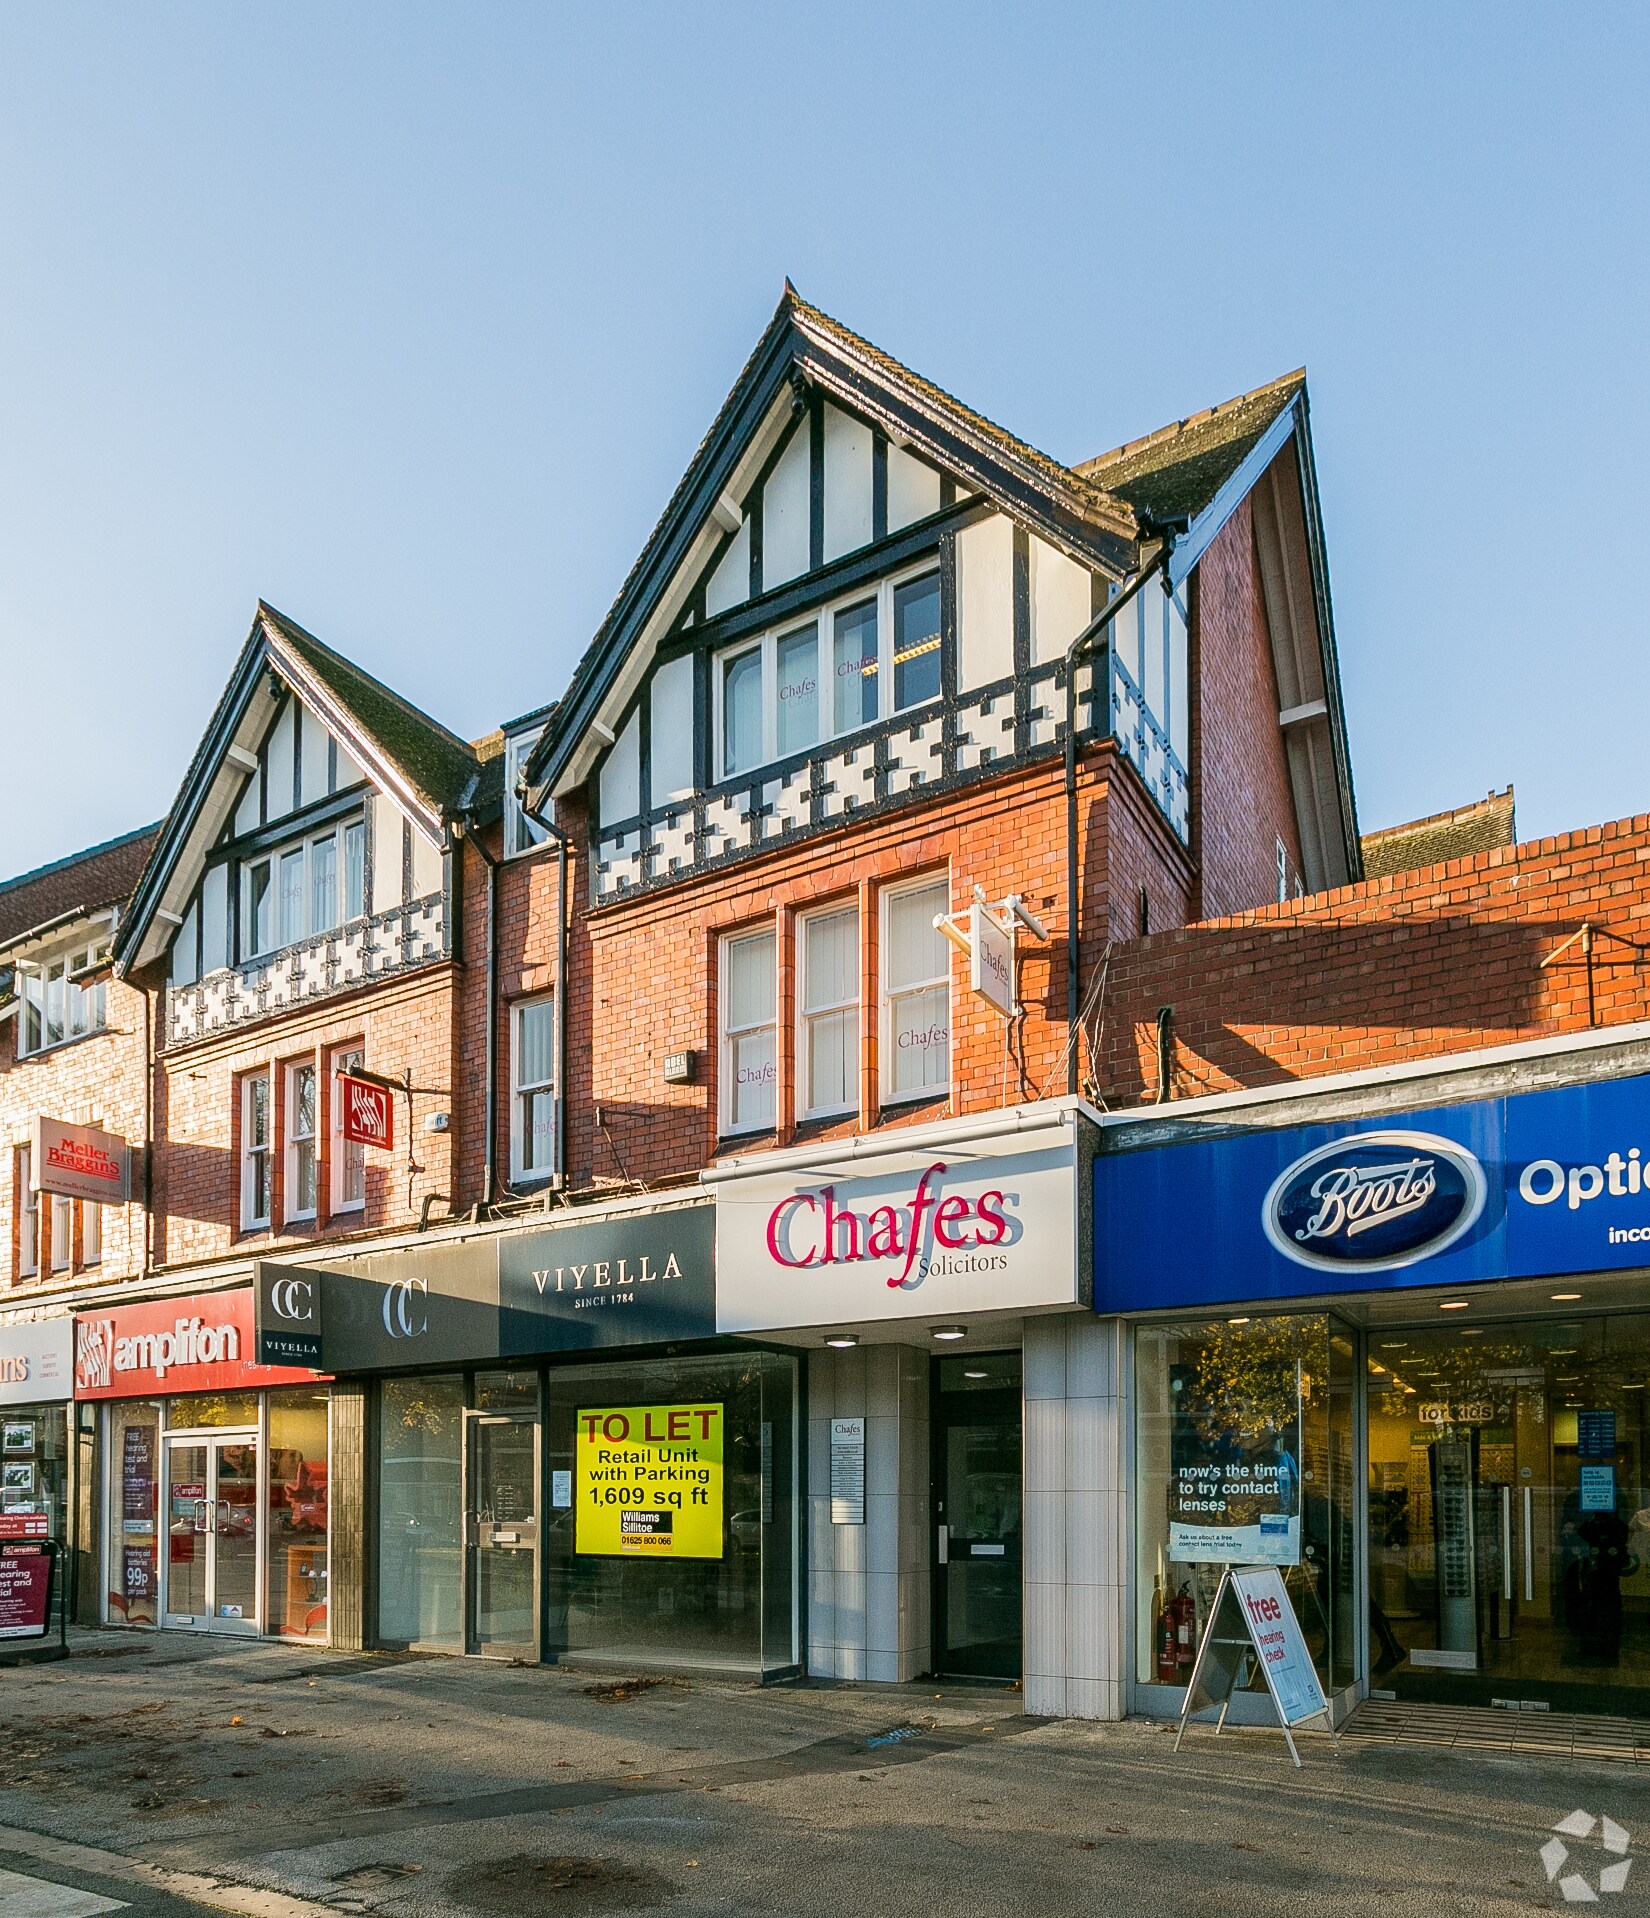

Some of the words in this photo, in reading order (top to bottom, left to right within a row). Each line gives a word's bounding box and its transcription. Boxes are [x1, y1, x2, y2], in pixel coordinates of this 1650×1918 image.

[780, 677, 816, 700] Chafes
[980, 941, 1008, 981] Chafes
[898, 1024, 948, 1050] Chafes
[60, 1139, 109, 1162] Meller
[48, 1147, 119, 1175] Braggins
[1519, 1148, 1650, 1210] Opti
[1295, 1157, 1435, 1240] Boots
[766, 1162, 1006, 1289] Chafes
[532, 1252, 683, 1294] VIYELLA
[918, 1253, 1008, 1278] Solicitors
[575, 1295, 606, 1309] SINCE
[611, 1293, 634, 1305] 1784
[114, 1317, 238, 1378] amplifon
[266, 1341, 318, 1354] VIYELLA
[581, 1413, 629, 1444] TO
[644, 1410, 718, 1441] LET
[835, 1423, 861, 1436] Chafes
[126, 1432, 140, 1441] FREE
[125, 1443, 147, 1453] hearing
[598, 1449, 650, 1464] Retail
[658, 1448, 698, 1463] Unit
[125, 1455, 136, 1463] test
[136, 1454, 148, 1463] and
[589, 1467, 627, 1481] with
[635, 1466, 710, 1483] Parking
[1179, 1464, 1221, 1478] now's
[1226, 1463, 1249, 1477] the
[1254, 1463, 1288, 1477] time
[181, 1485, 202, 1497] amplifon
[1179, 1481, 1193, 1494] to
[1198, 1481, 1218, 1496] try
[1222, 1481, 1279, 1494] contact
[589, 1487, 645, 1506] 1,609
[653, 1491, 682, 1509] sq
[691, 1486, 709, 1505] ft
[1179, 1498, 1226, 1511] lenses
[622, 1511, 660, 1522] Williams
[622, 1522, 653, 1533] Sillitoe
[621, 1536, 642, 1545] 01625
[13, 1546, 40, 1554] amplifon
[127, 1558, 148, 1567] batteries
[0, 1569, 31, 1580] earing
[0, 1580, 11, 1588] est
[13, 1577, 33, 1587] and
[127, 1567, 149, 1587] 99p
[0, 1588, 12, 1597] ial
[1246, 1593, 1282, 1625] free
[1258, 1629, 1286, 1646] hearing
[1265, 1646, 1286, 1663] check
